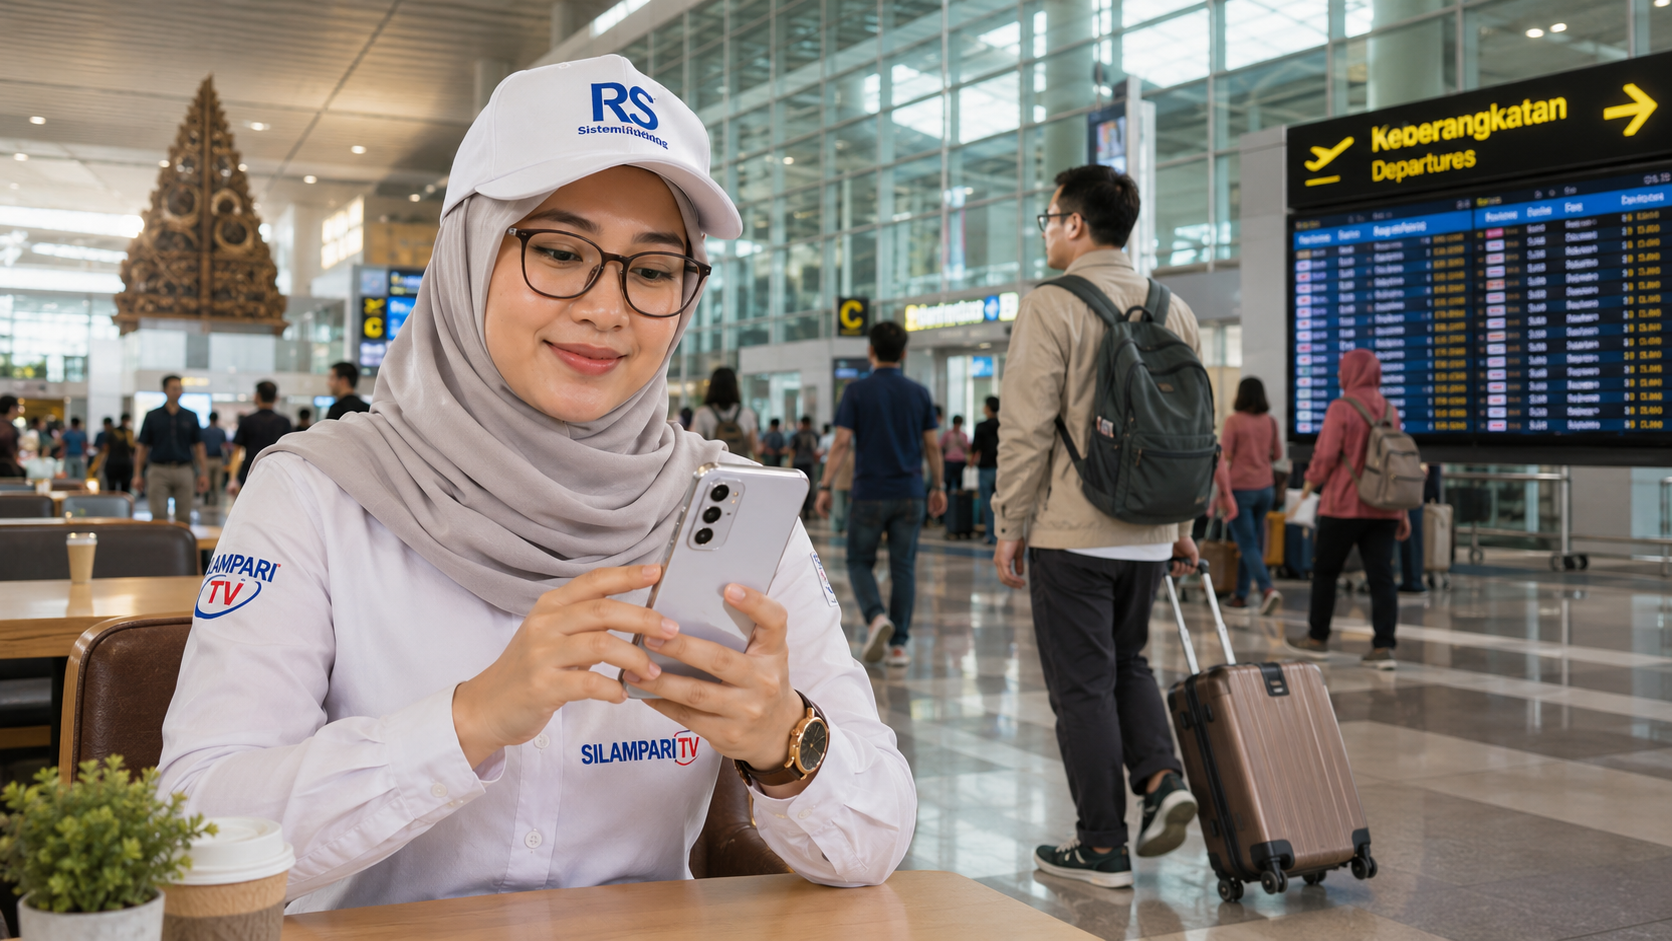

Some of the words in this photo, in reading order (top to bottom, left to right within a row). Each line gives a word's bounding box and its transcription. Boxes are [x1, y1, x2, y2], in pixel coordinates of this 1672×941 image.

[591, 82, 658, 130] RS
[1372, 151, 1476, 184] Departures
[840, 300, 863, 330] C
[207, 554, 277, 582] LAMPARI
[208, 580, 244, 606] TV
